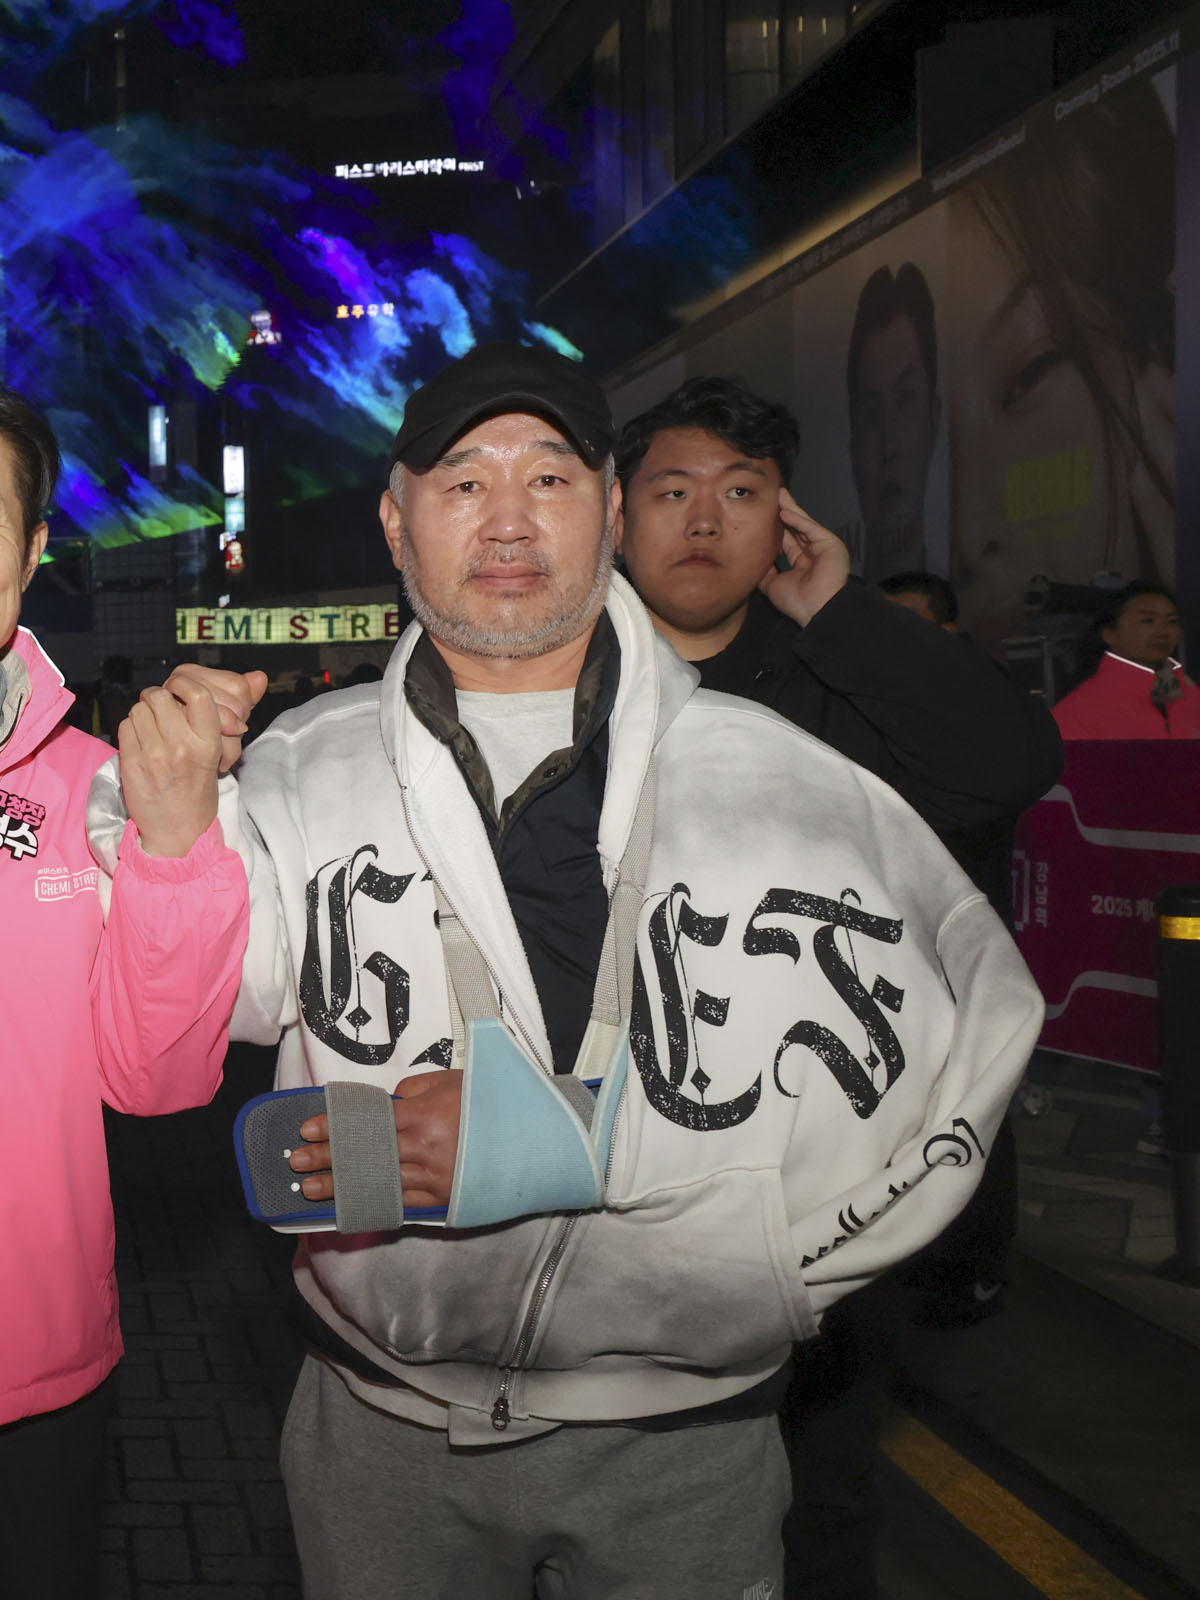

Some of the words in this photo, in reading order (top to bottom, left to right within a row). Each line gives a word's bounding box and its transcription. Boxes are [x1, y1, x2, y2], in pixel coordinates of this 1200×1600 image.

[40, 880, 71, 896] CHEMI
[73, 872, 98, 889] STRE
[1090, 894, 1133, 918] 2025
